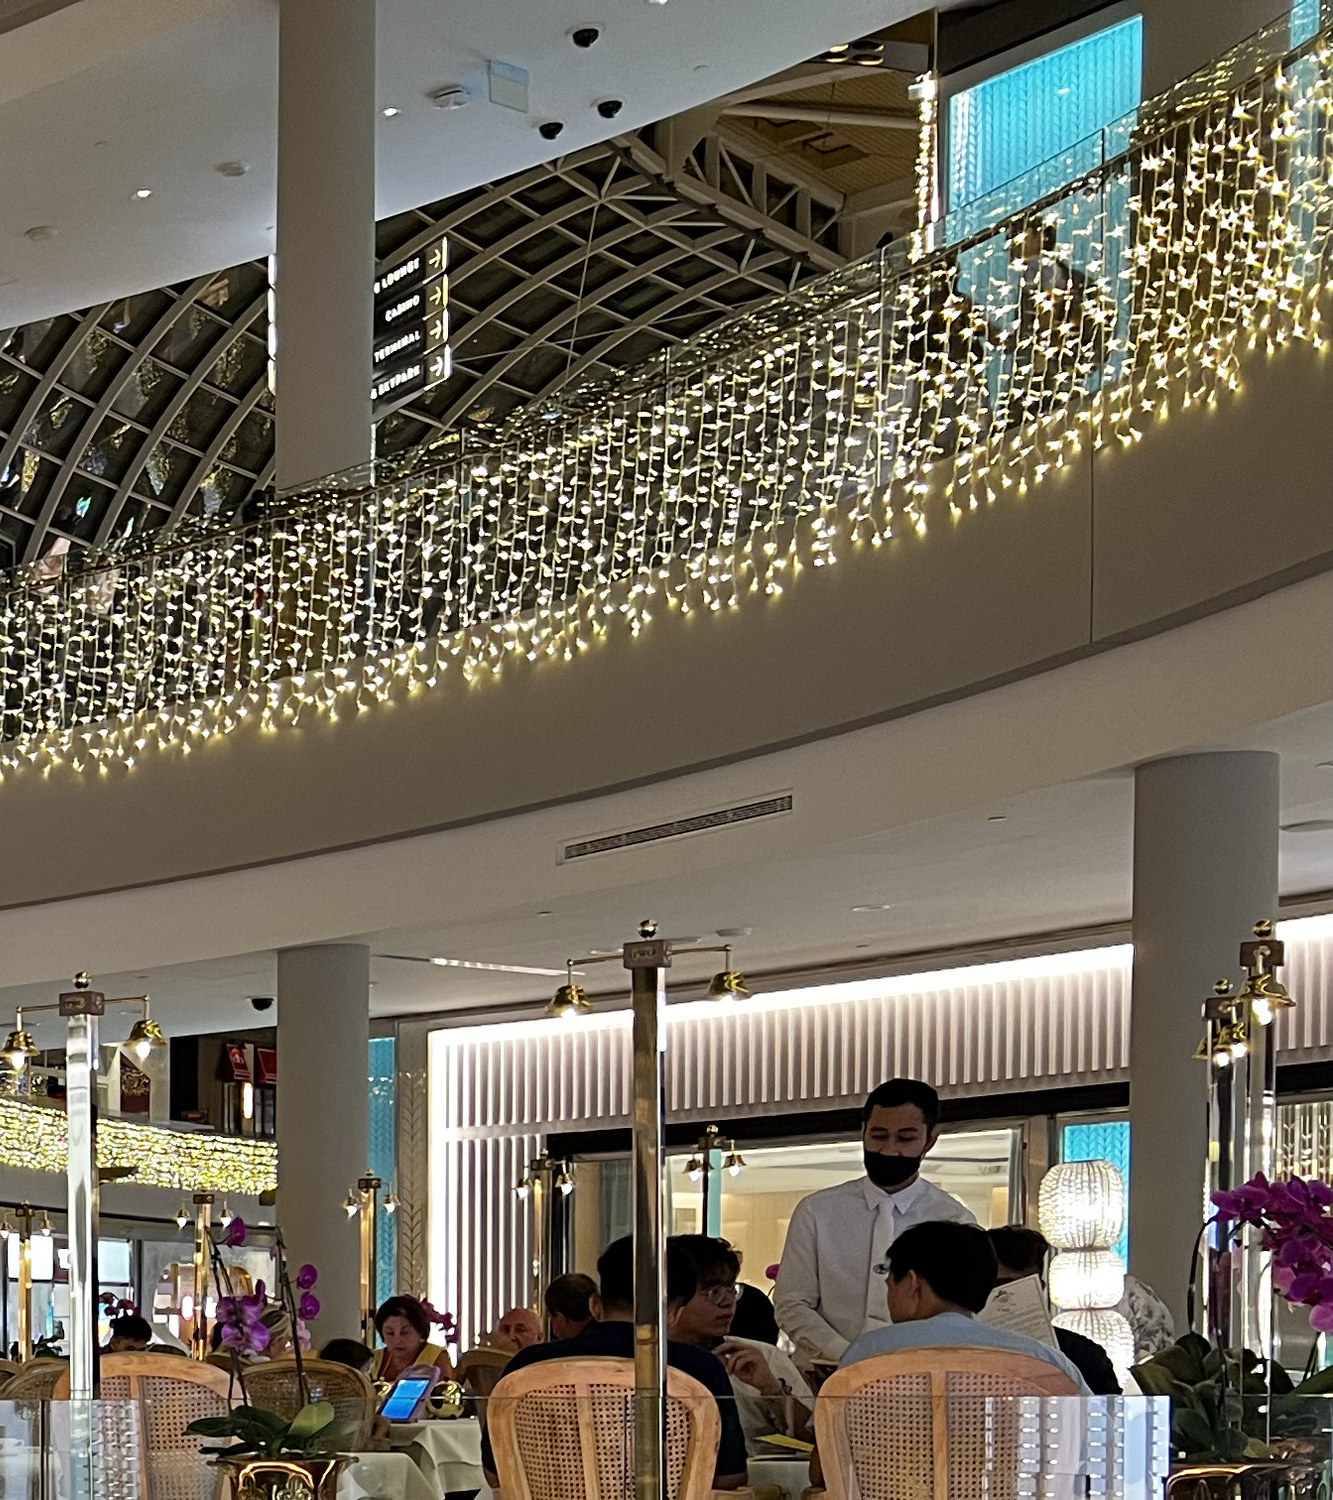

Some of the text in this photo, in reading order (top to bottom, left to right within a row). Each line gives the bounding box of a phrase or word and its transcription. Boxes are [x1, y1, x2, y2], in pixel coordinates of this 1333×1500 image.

[382, 257, 420, 289] LOUNGE
[384, 294, 420, 322] CASINO
[374, 330, 421, 363] TERMINAL
